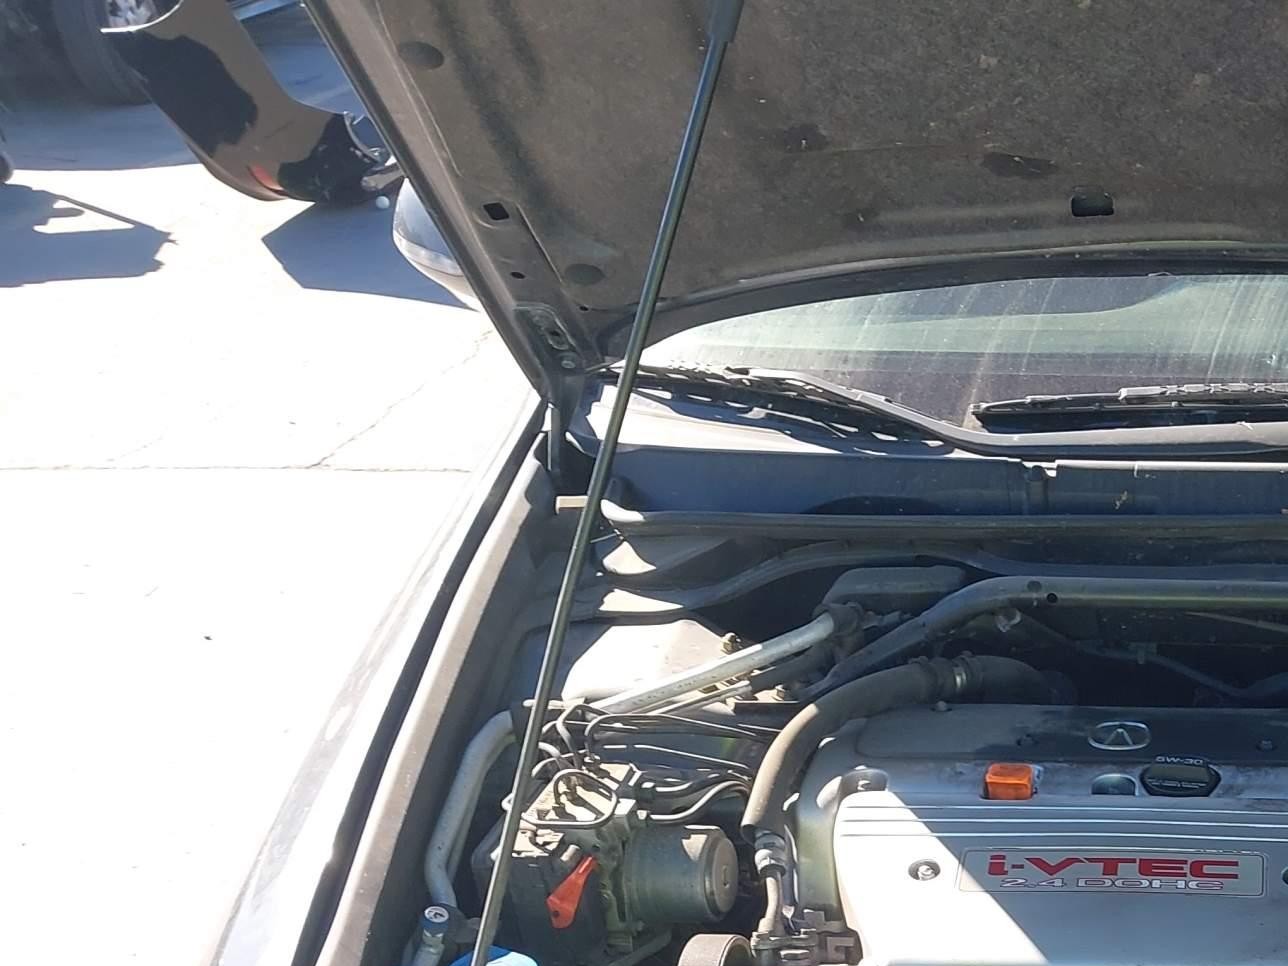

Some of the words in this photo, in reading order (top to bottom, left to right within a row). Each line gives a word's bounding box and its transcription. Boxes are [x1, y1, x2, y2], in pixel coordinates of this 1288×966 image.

[1155, 755, 1204, 766] 5W-30
[987, 853, 1240, 879] i-VTEC
[1000, 877, 1065, 888] 2.4
[1075, 878, 1224, 890] DOHC
